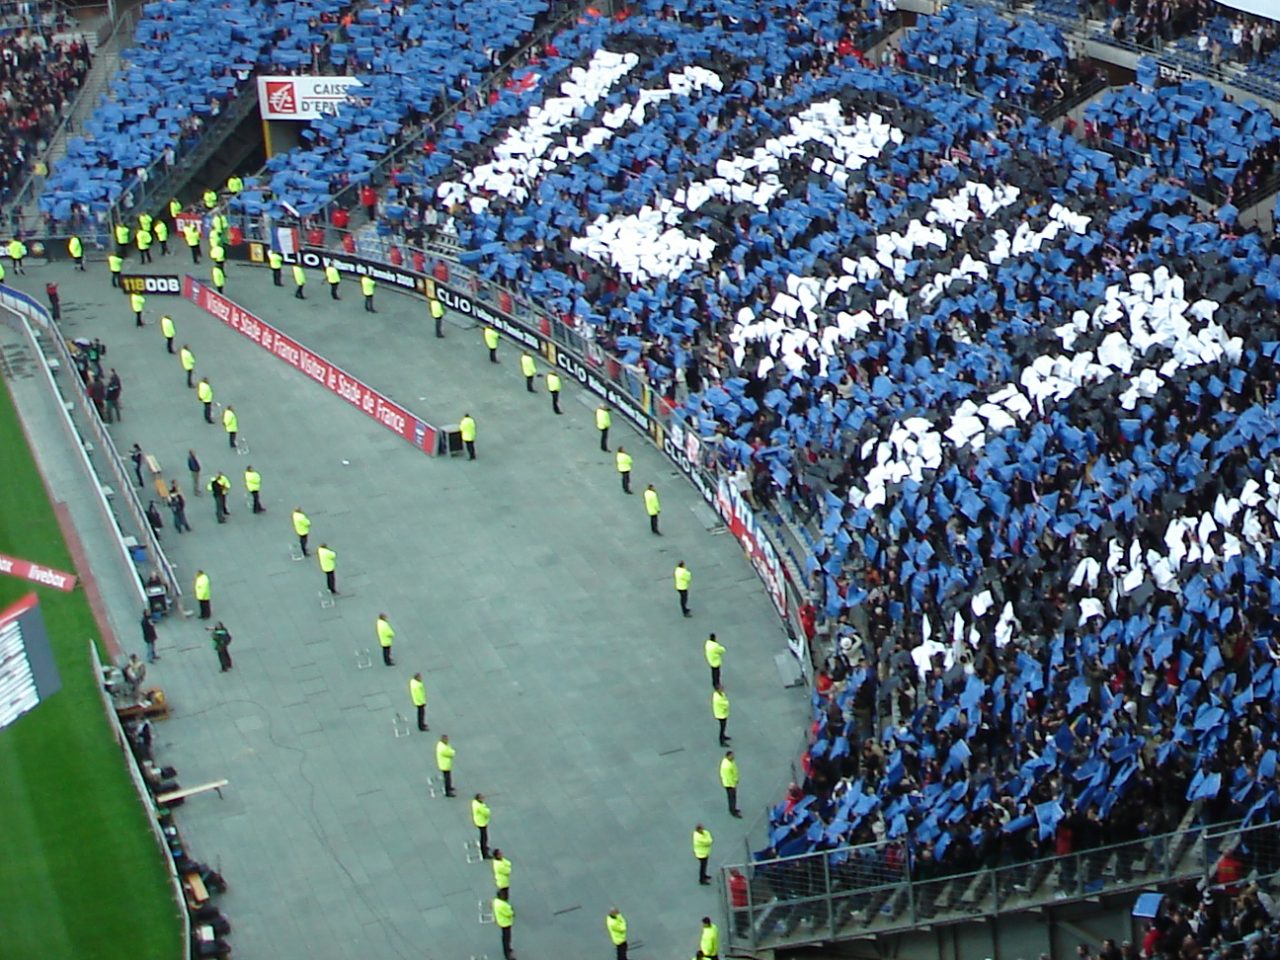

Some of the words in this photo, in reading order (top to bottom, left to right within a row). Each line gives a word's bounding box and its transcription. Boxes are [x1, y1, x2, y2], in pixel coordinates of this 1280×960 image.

[313, 83, 348, 95] CAISS
[436, 287, 471, 313] CLIO
[205, 291, 230, 322] Visitez
[231, 305, 240, 328] le
[239, 311, 261, 342] Stade
[261, 328, 272, 351] de
[273, 336, 300, 366] France
[300, 348, 326, 384] Visitez
[327, 366, 337, 390] le
[337, 373, 361, 406] Stade
[362, 392, 374, 415] de
[376, 400, 406, 435] France
[557, 353, 587, 383] CLIO
[664, 437, 690, 474] CLIO
[28, 563, 67, 589] livebox
